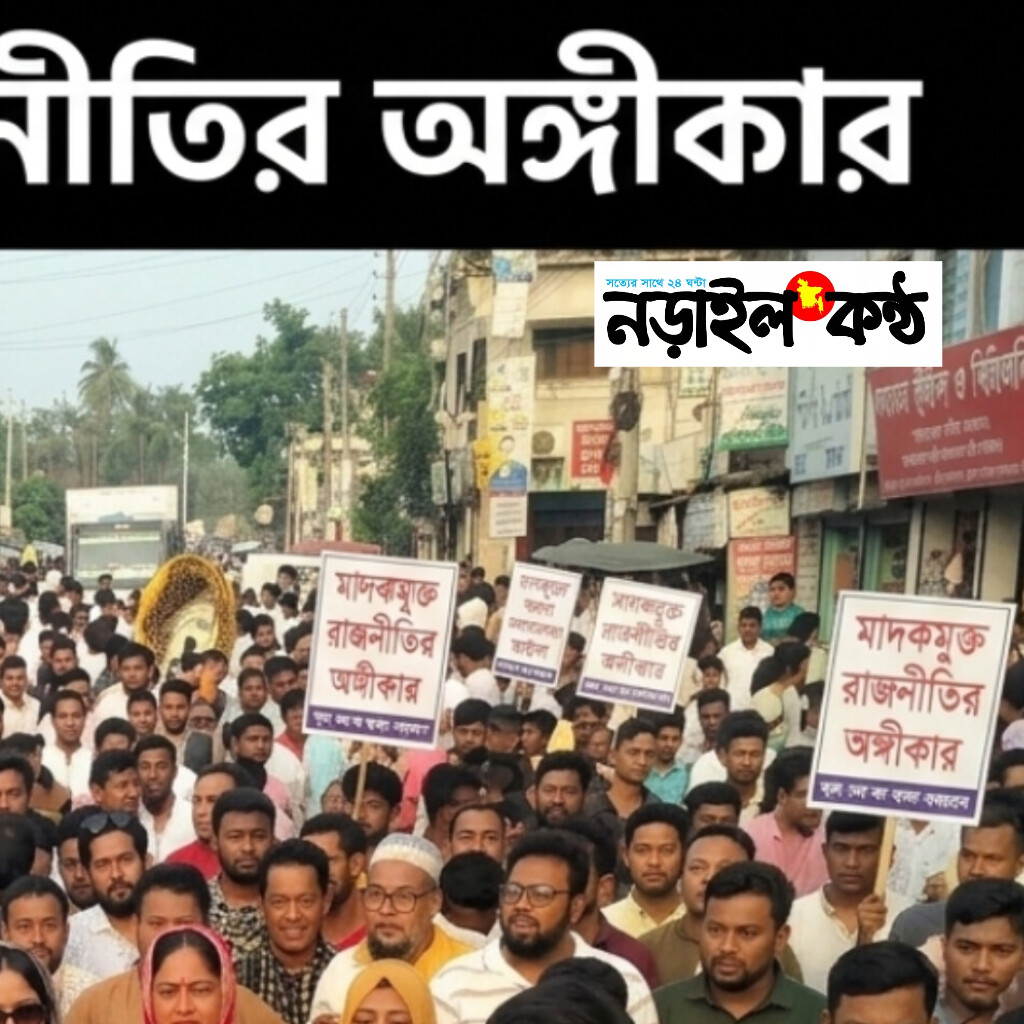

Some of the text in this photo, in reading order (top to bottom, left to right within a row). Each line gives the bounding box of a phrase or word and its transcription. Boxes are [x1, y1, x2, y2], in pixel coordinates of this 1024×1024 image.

[856, 615, 990, 664] মাদকমুক্ত
[841, 663, 986, 717] রাজনীতির
[843, 718, 964, 772] অঙ্গীকার
